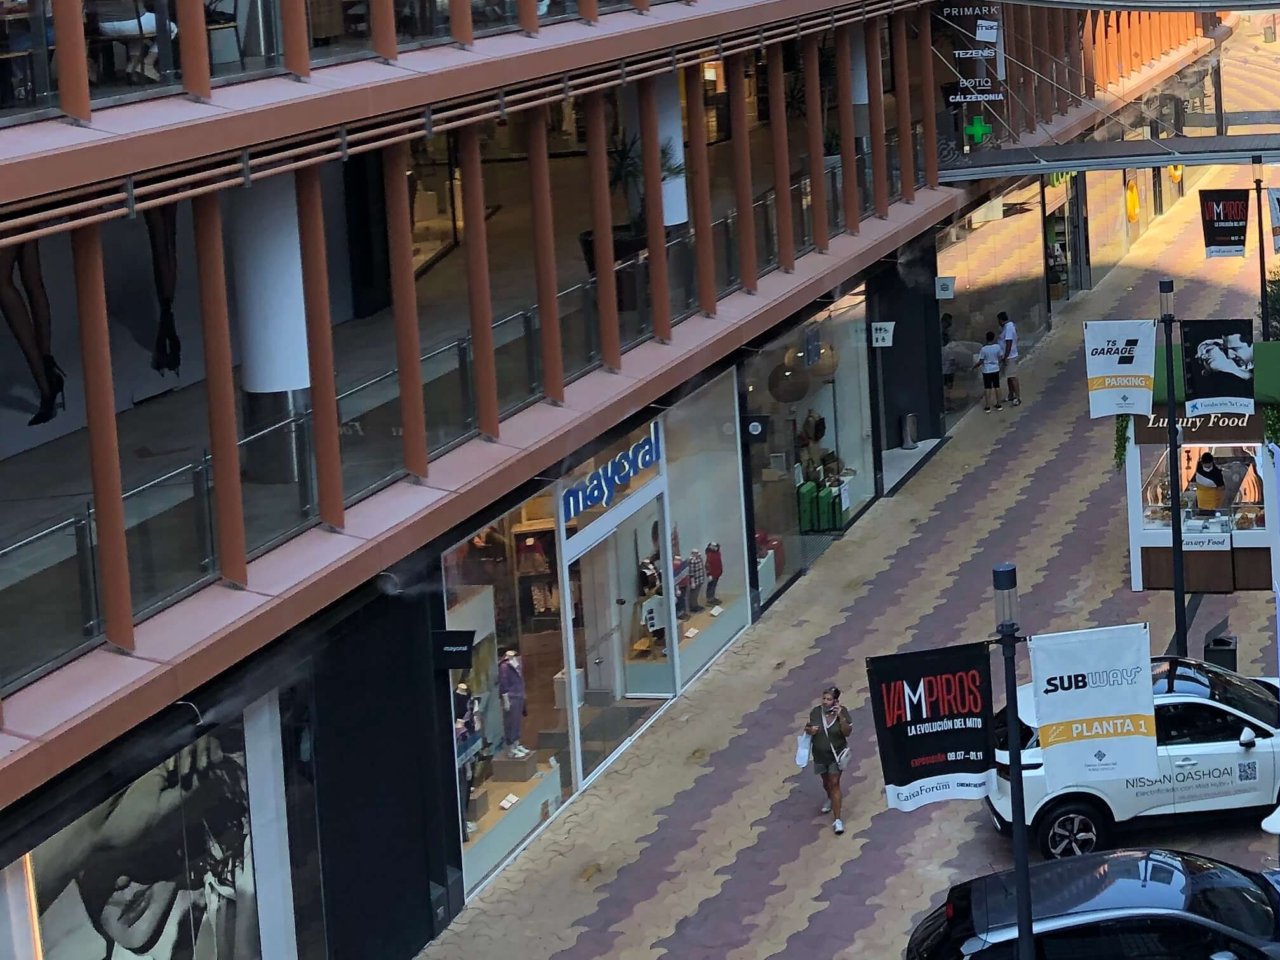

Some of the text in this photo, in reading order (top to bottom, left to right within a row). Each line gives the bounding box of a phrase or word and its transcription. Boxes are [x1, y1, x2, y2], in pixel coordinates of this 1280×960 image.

[943, 5, 999, 17] PRIMARK
[949, 94, 1004, 103] CALZEDONIA
[1090, 346, 1135, 357] GARAGE
[1106, 339, 1117, 347] TS
[1105, 377, 1145, 387] PARKING
[1147, 414, 1250, 431] Luury Food
[561, 420, 661, 523] mayoral
[1207, 538, 1225, 546] Food
[1043, 666, 1142, 695] SUBWAY
[881, 669, 983, 728] VAMPIROS
[907, 717, 982, 737] LA EVOLUCIÓN DEL MITO
[1072, 719, 1148, 738] PLANTA 1
[1125, 767, 1233, 789] NISSAN QASHQAI
[896, 783, 951, 802] CaixaForum
